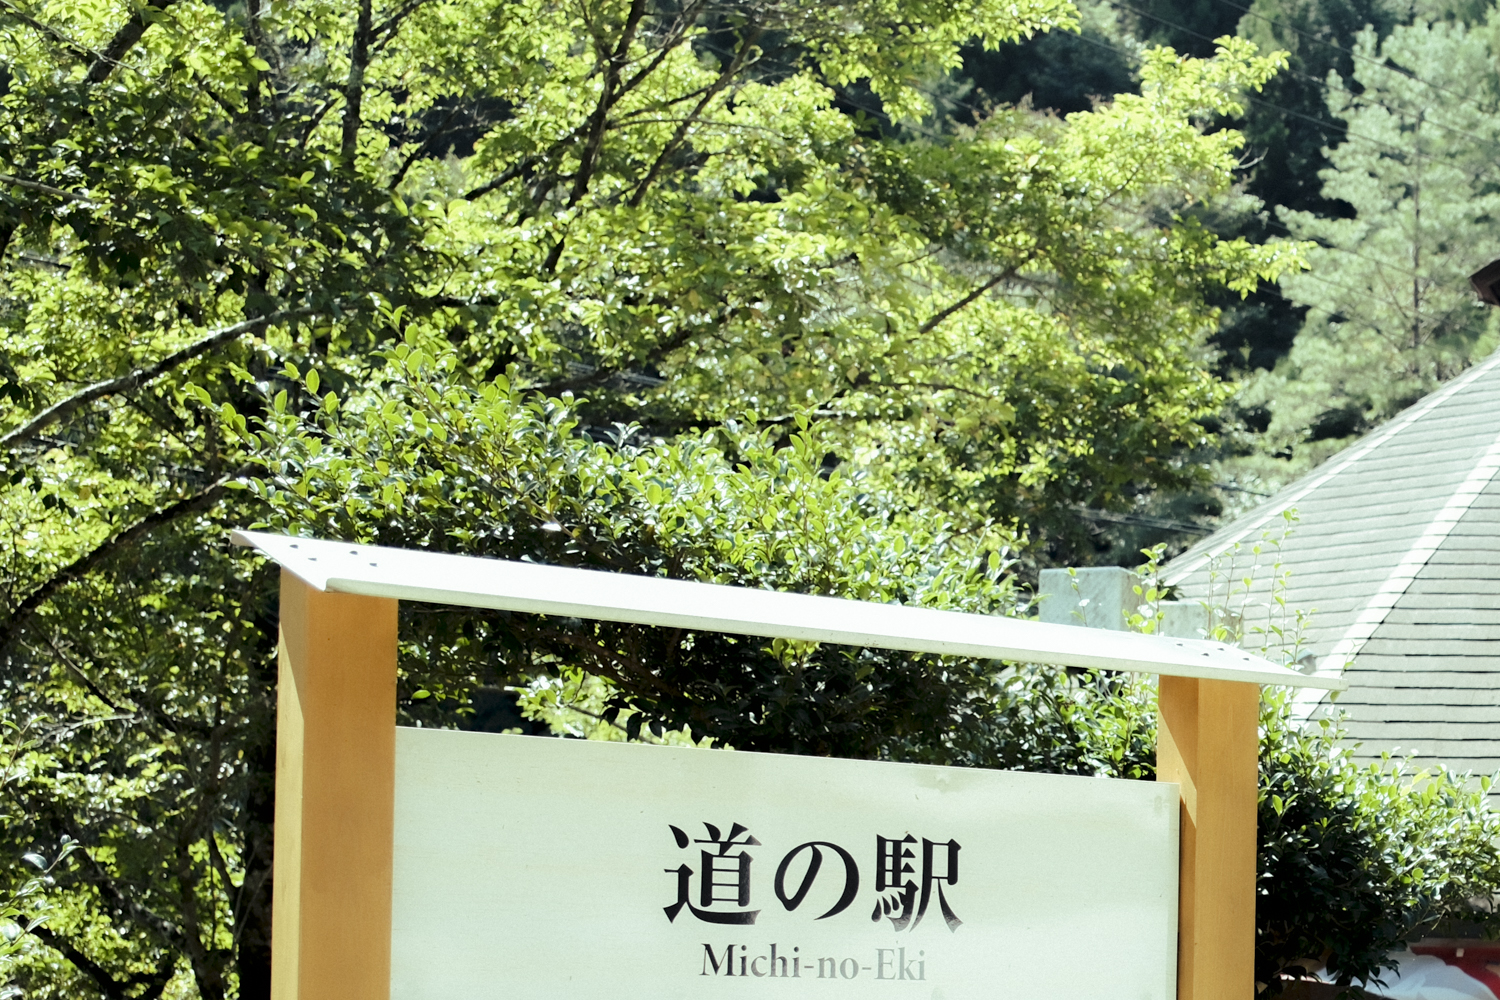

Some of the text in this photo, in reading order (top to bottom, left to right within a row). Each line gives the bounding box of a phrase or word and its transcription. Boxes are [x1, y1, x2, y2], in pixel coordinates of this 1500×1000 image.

[663, 822, 963, 933] 道の駅
[699, 943, 926, 981] Michi-no-Eki
